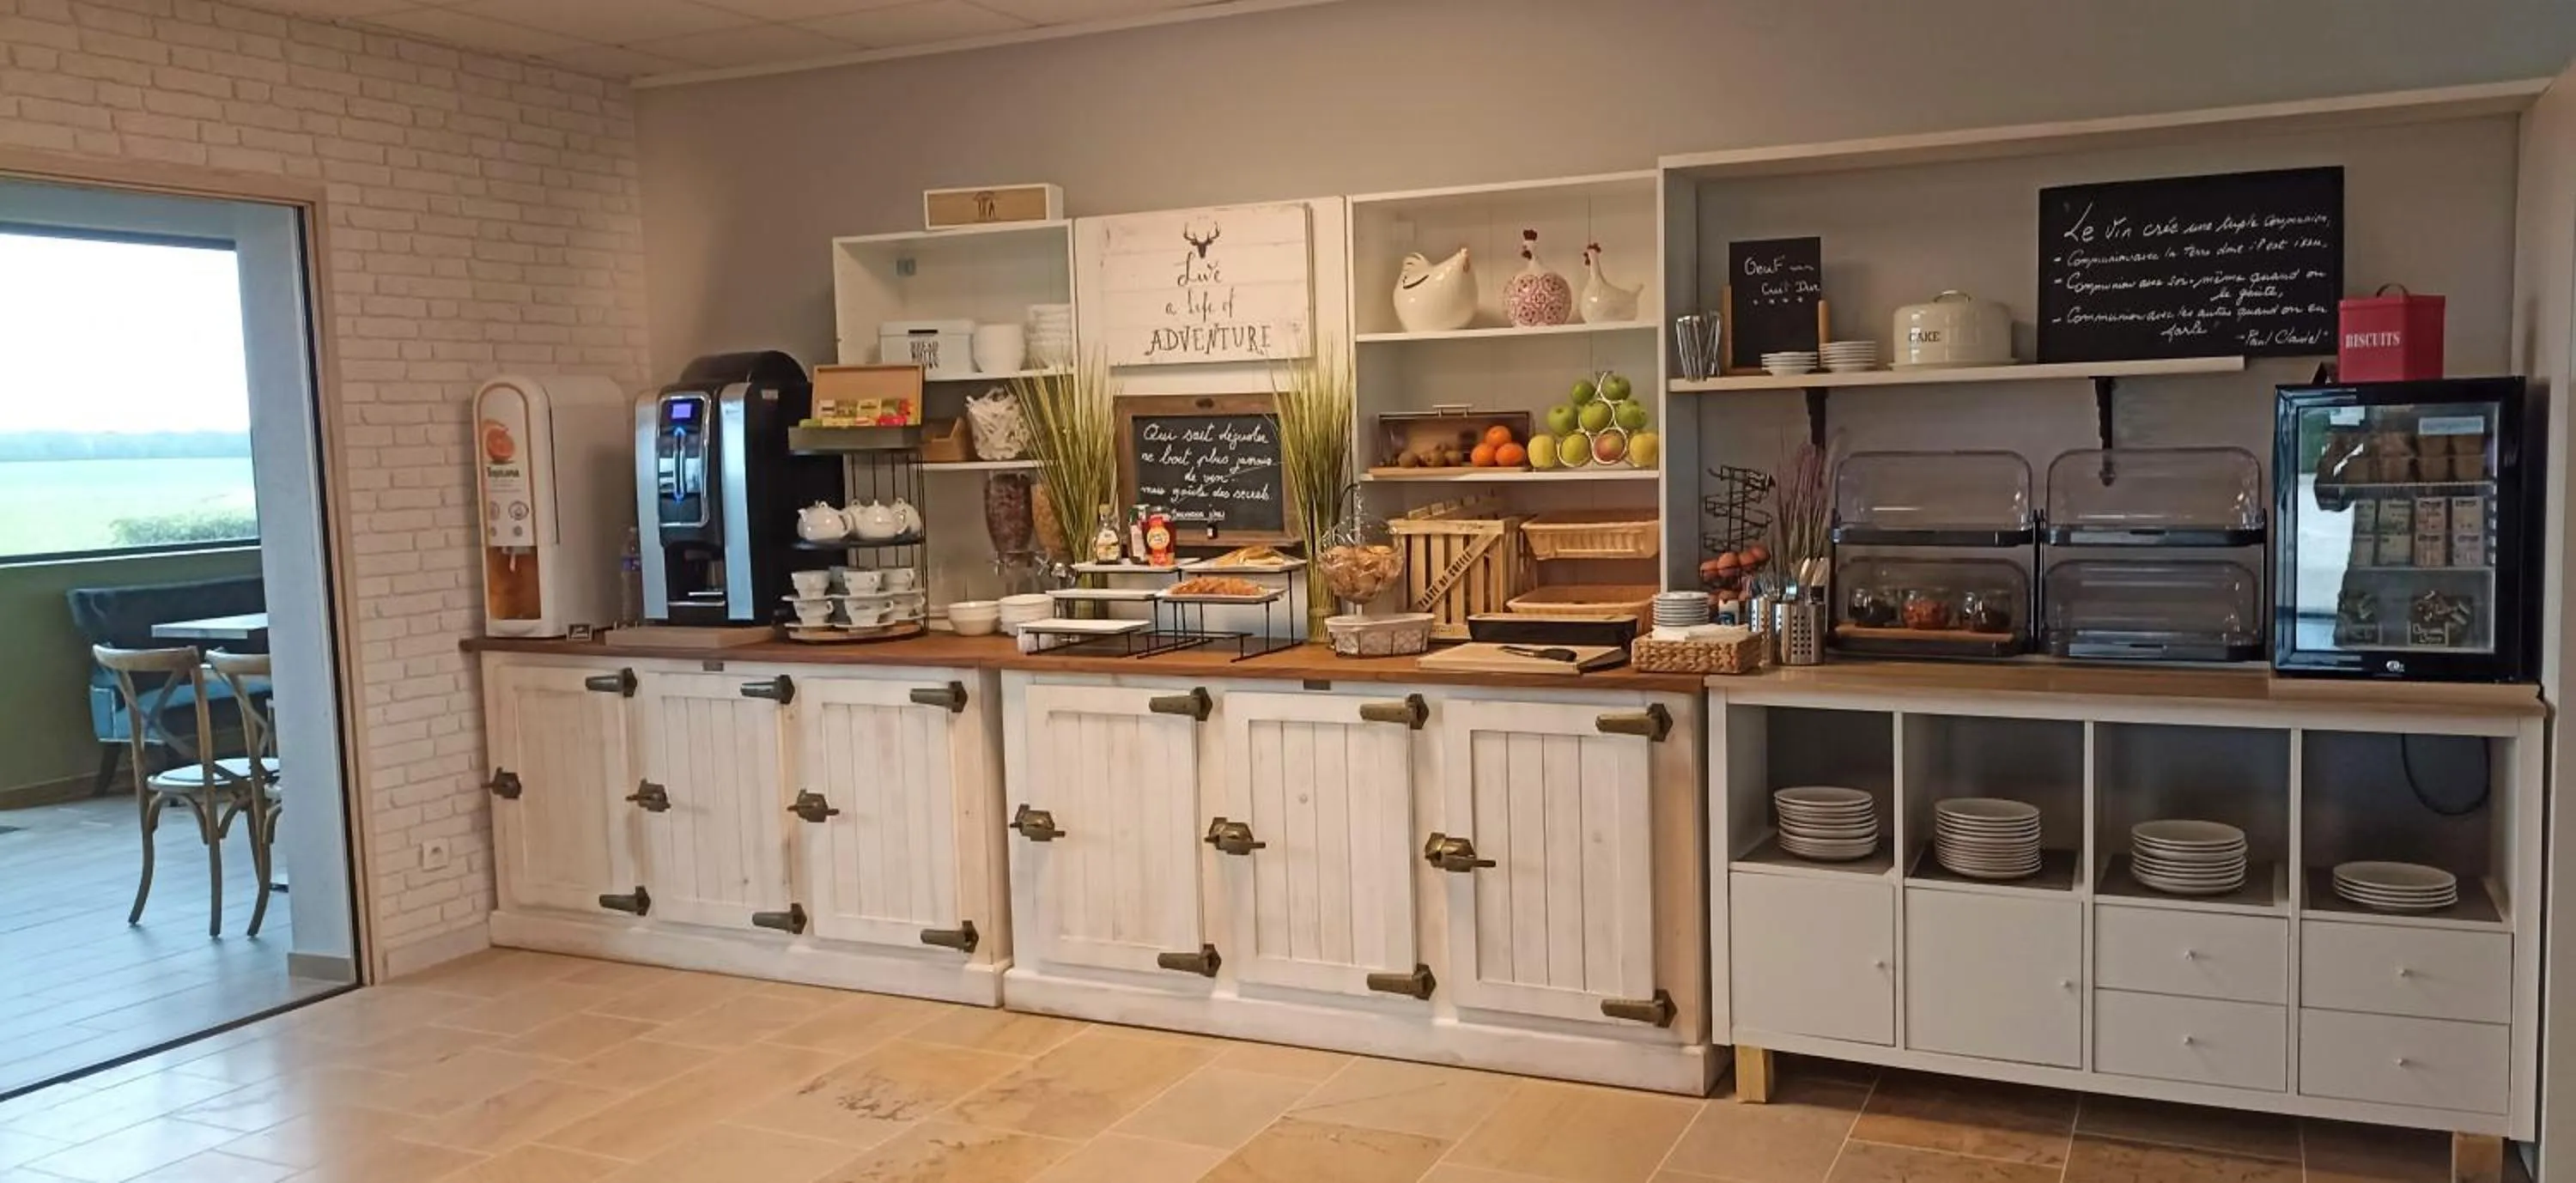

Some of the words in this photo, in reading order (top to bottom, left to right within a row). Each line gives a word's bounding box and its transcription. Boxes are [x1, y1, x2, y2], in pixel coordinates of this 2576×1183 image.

[1177, 252, 1223, 287] Live
[1187, 288, 1216, 323] life
[1144, 323, 1273, 356] ADVENTURE
[1909, 331, 1941, 343] CAKE
[2345, 331, 2402, 349] BISCUITS
[1143, 422, 1177, 440] Qui
